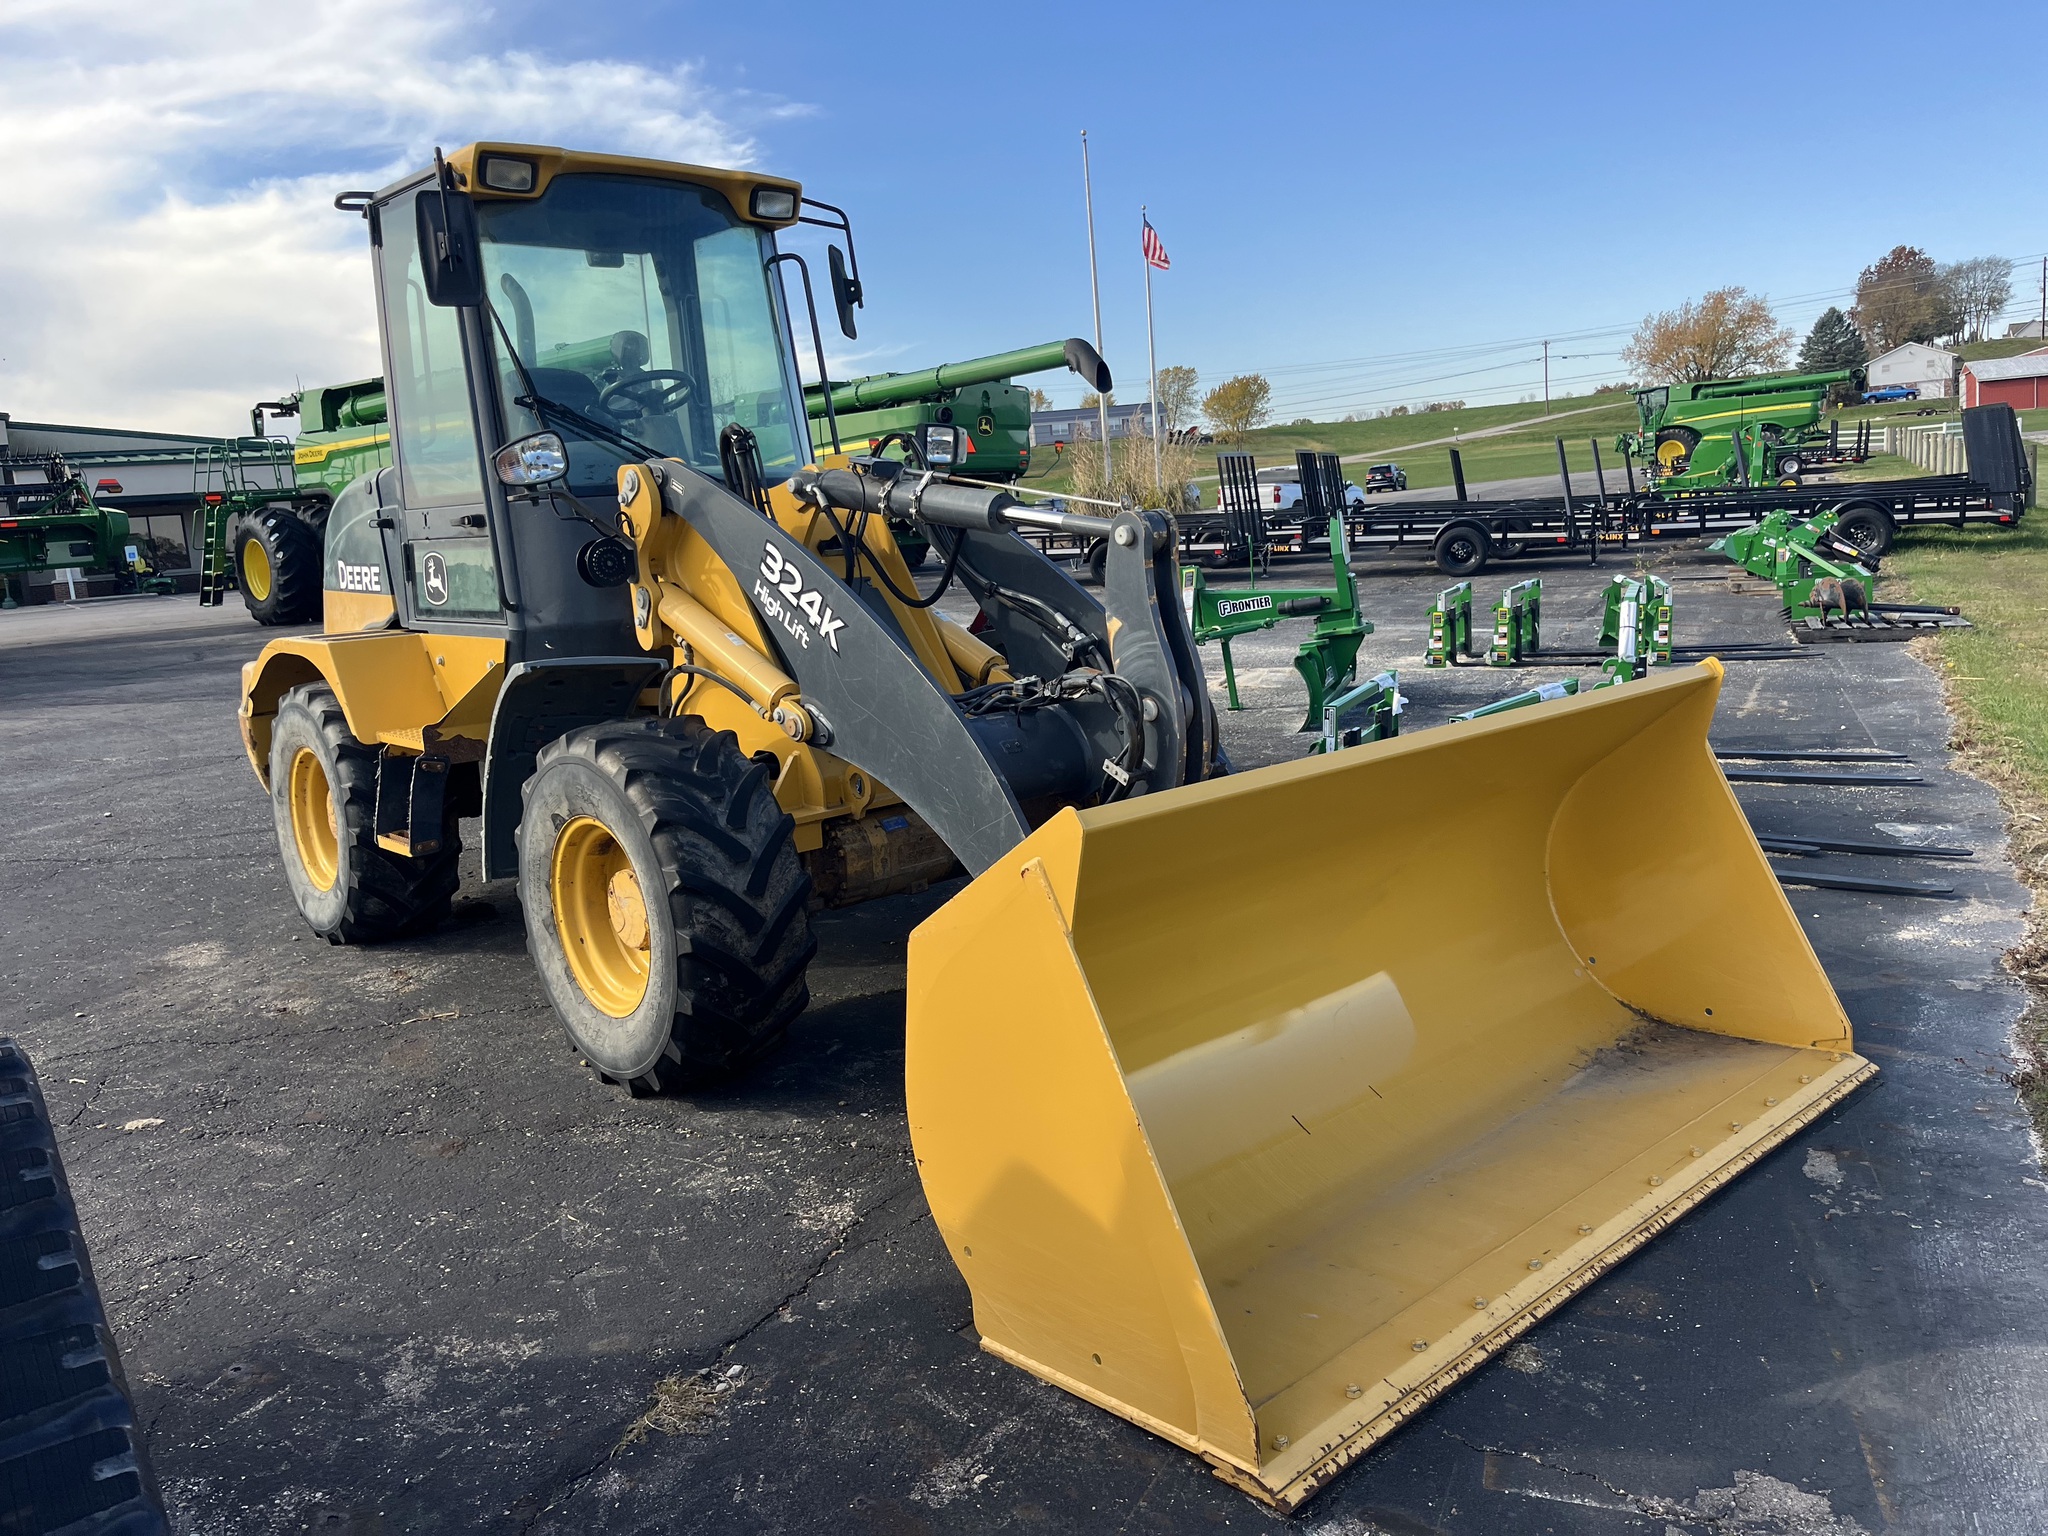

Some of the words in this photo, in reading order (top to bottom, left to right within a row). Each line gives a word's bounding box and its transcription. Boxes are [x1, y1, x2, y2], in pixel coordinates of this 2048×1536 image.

[337, 560, 381, 591] DEERE
[760, 541, 846, 654] 324K
[754, 579, 784, 622] High
[783, 611, 811, 650] Lift
[1219, 596, 1271, 616] FRONTIER
